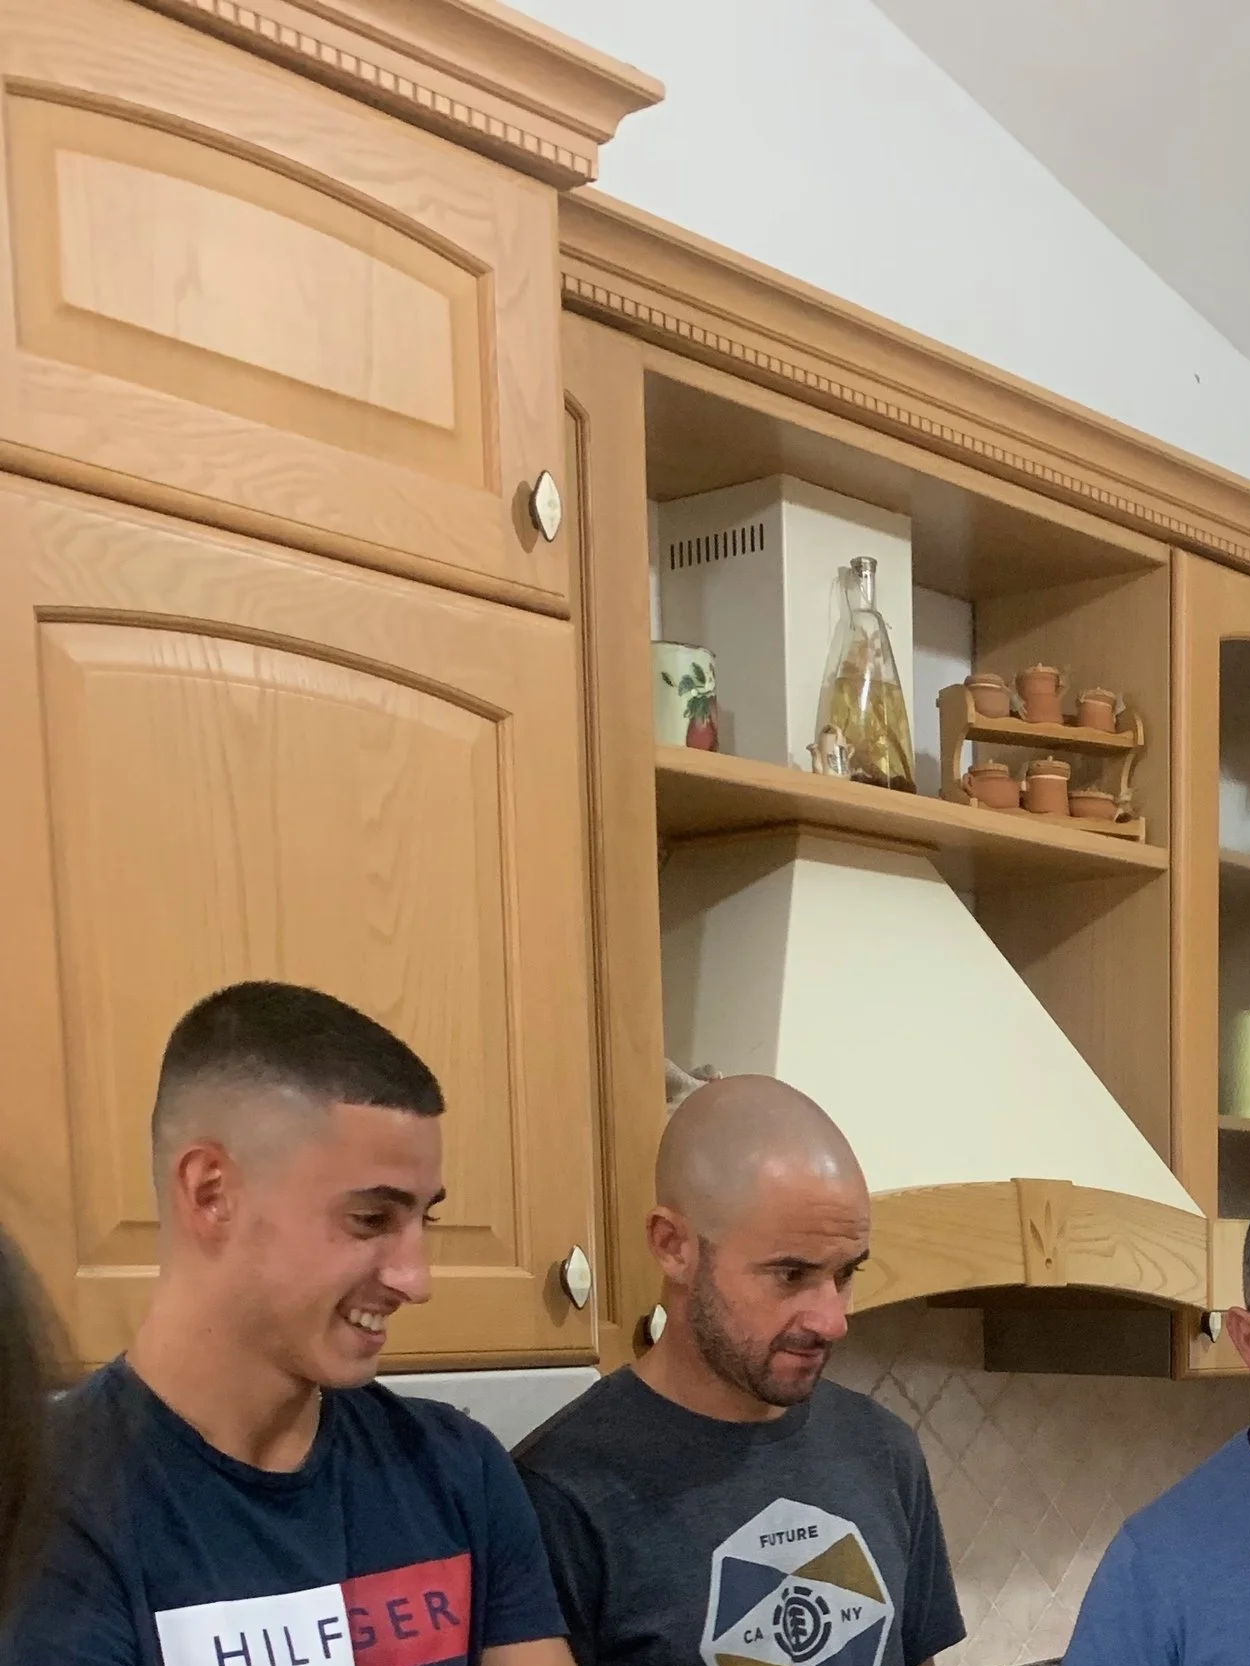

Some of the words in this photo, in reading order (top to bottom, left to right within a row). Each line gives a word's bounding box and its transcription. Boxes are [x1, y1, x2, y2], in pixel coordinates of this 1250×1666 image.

[759, 1525, 819, 1548] FUTURE
[743, 1627, 764, 1644] CA
[840, 1606, 862, 1623] NY
